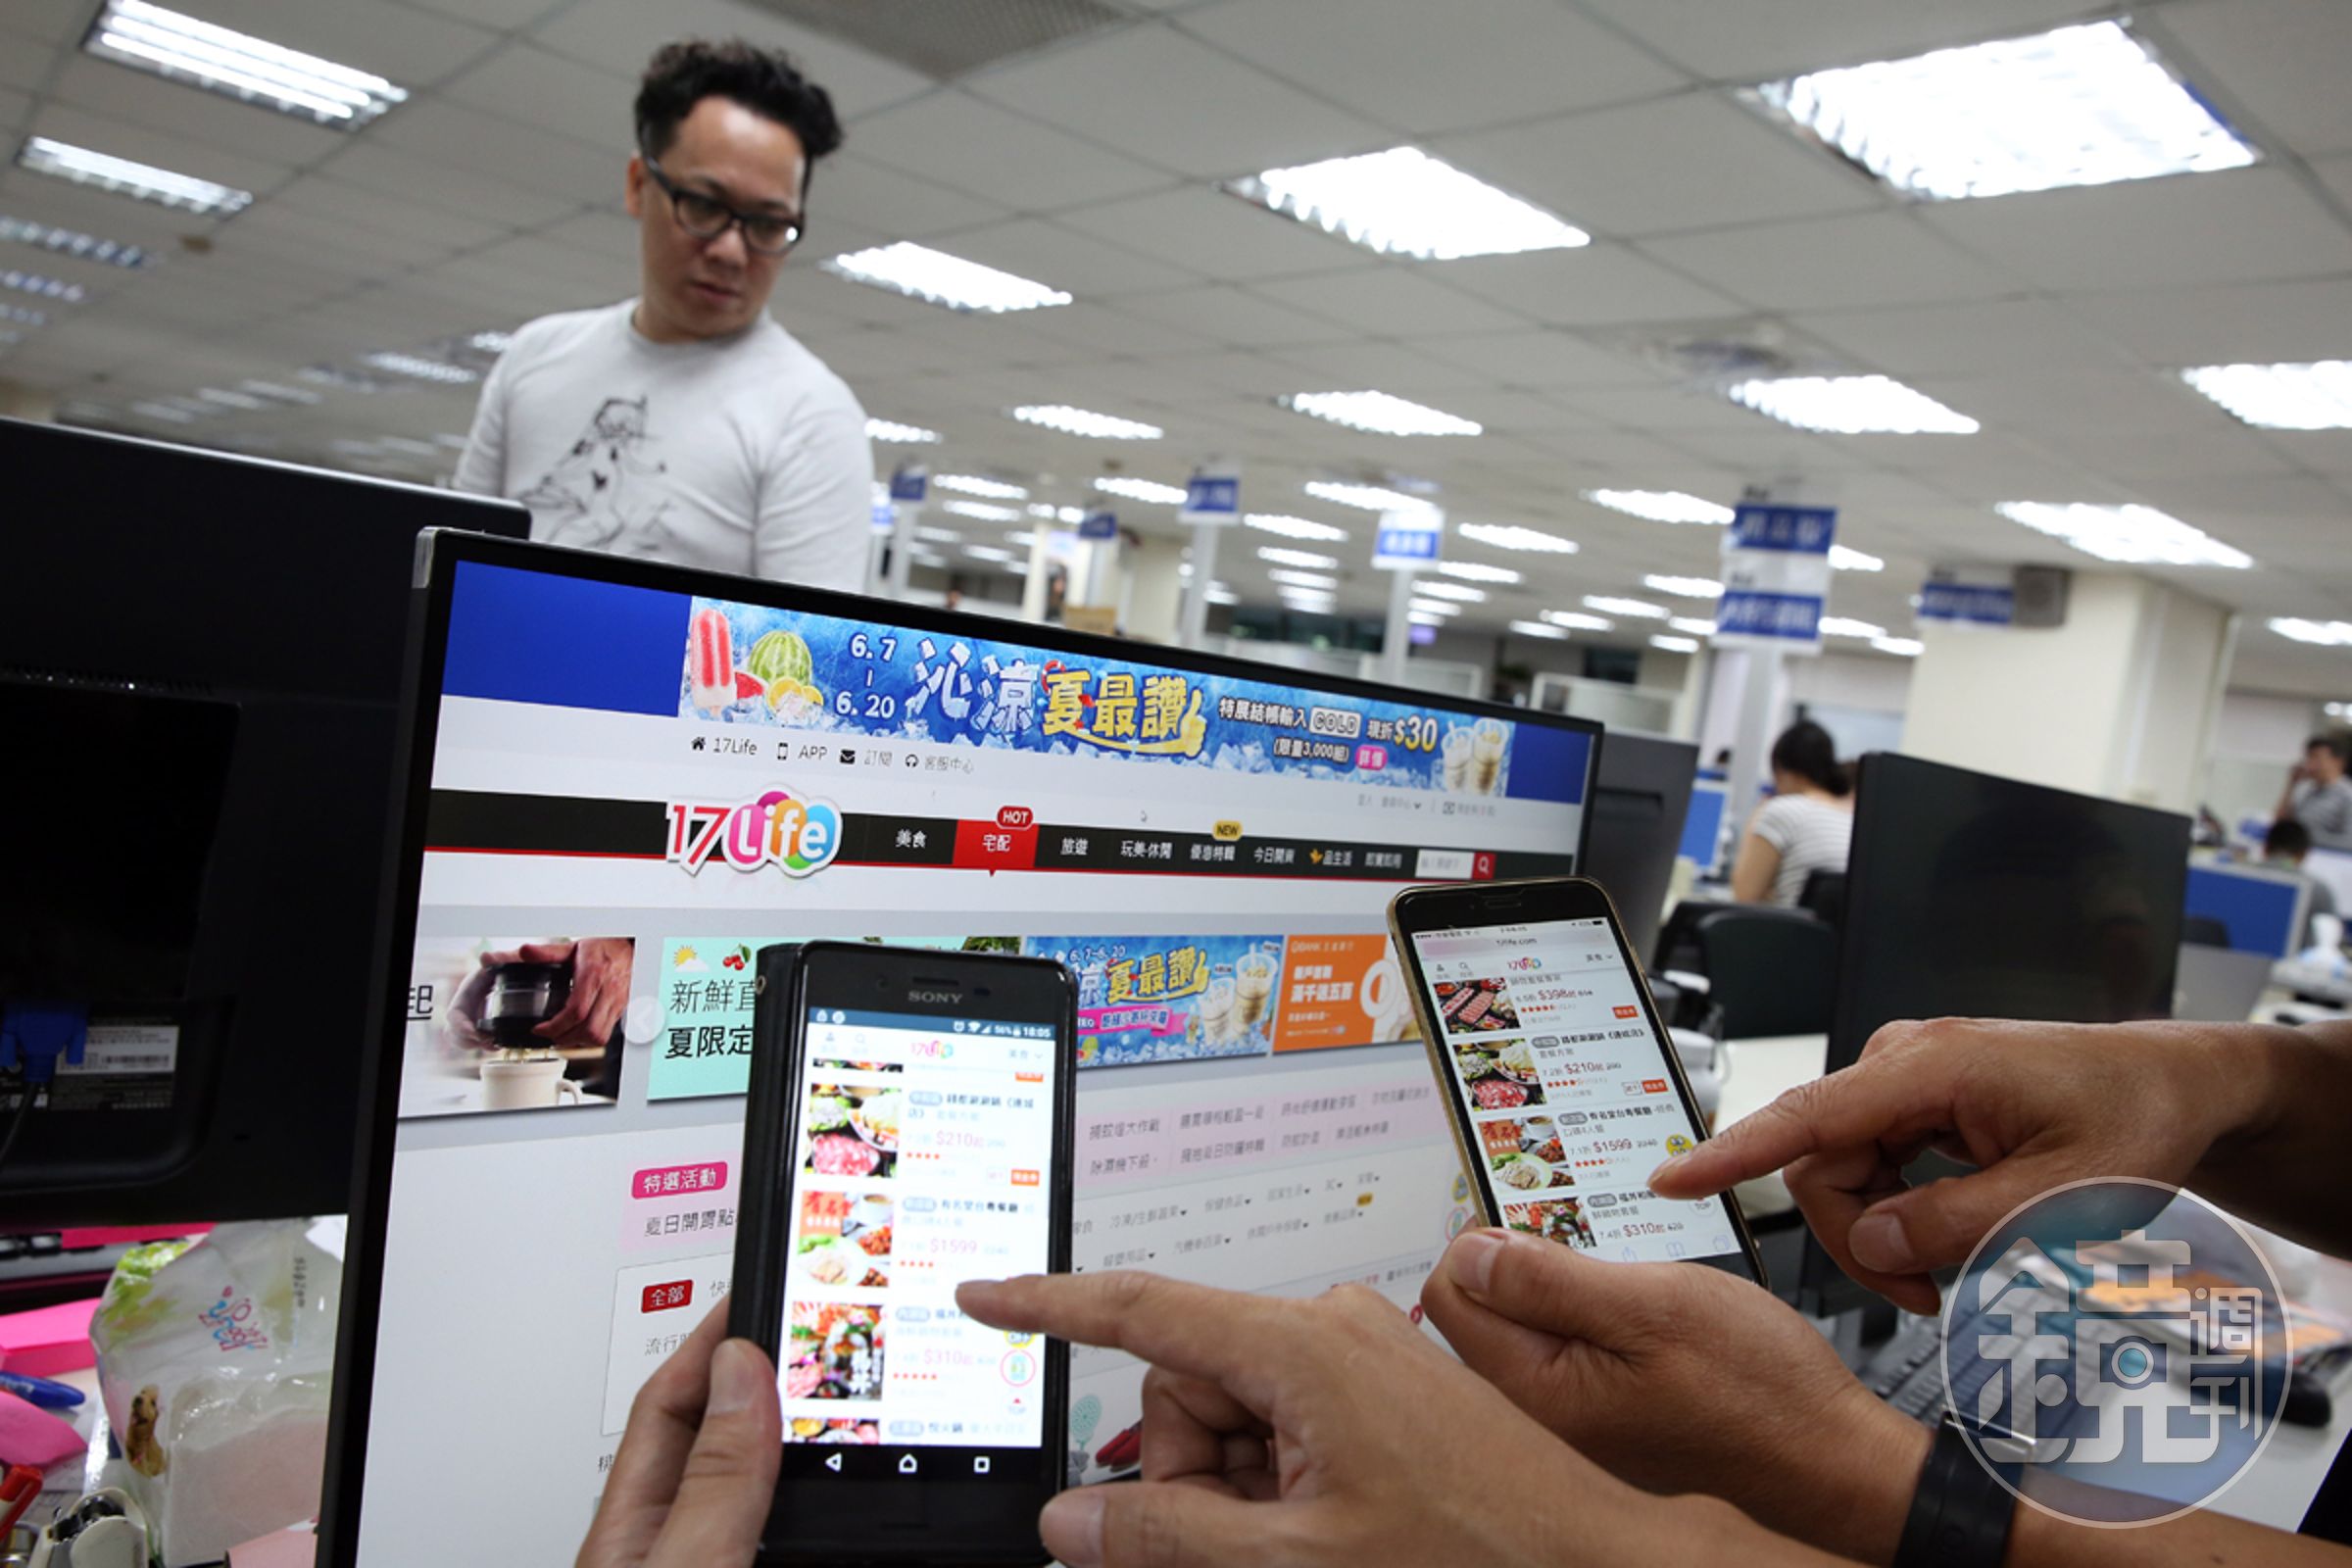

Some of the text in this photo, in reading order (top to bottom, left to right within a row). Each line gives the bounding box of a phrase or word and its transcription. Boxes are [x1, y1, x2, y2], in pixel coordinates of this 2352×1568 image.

[851, 632, 897, 662] 6.7
[836, 691, 896, 719] 6.20
[1311, 710, 1358, 736] COLD
[1394, 712, 1439, 753] $30
[712, 737, 758, 757] 17Life
[798, 744, 828, 761] APP
[1002, 809, 1030, 825] HOT
[672, 796, 833, 866] 17Life
[1217, 823, 1239, 837] NEW
[895, 828, 927, 849] 美食
[982, 833, 1011, 853] 宅配
[1059, 837, 1090, 857] 旅遊
[907, 990, 963, 1004] SONY
[664, 1025, 754, 1060] 夏限定
[1022, 1027, 1052, 1039] 18:05
[1592, 1139, 1633, 1153] $1599
[643, 1167, 717, 1194] 特選活動
[930, 1238, 978, 1254] $1599
[651, 1285, 685, 1306] 全部
[644, 1333, 689, 1356] 流行
